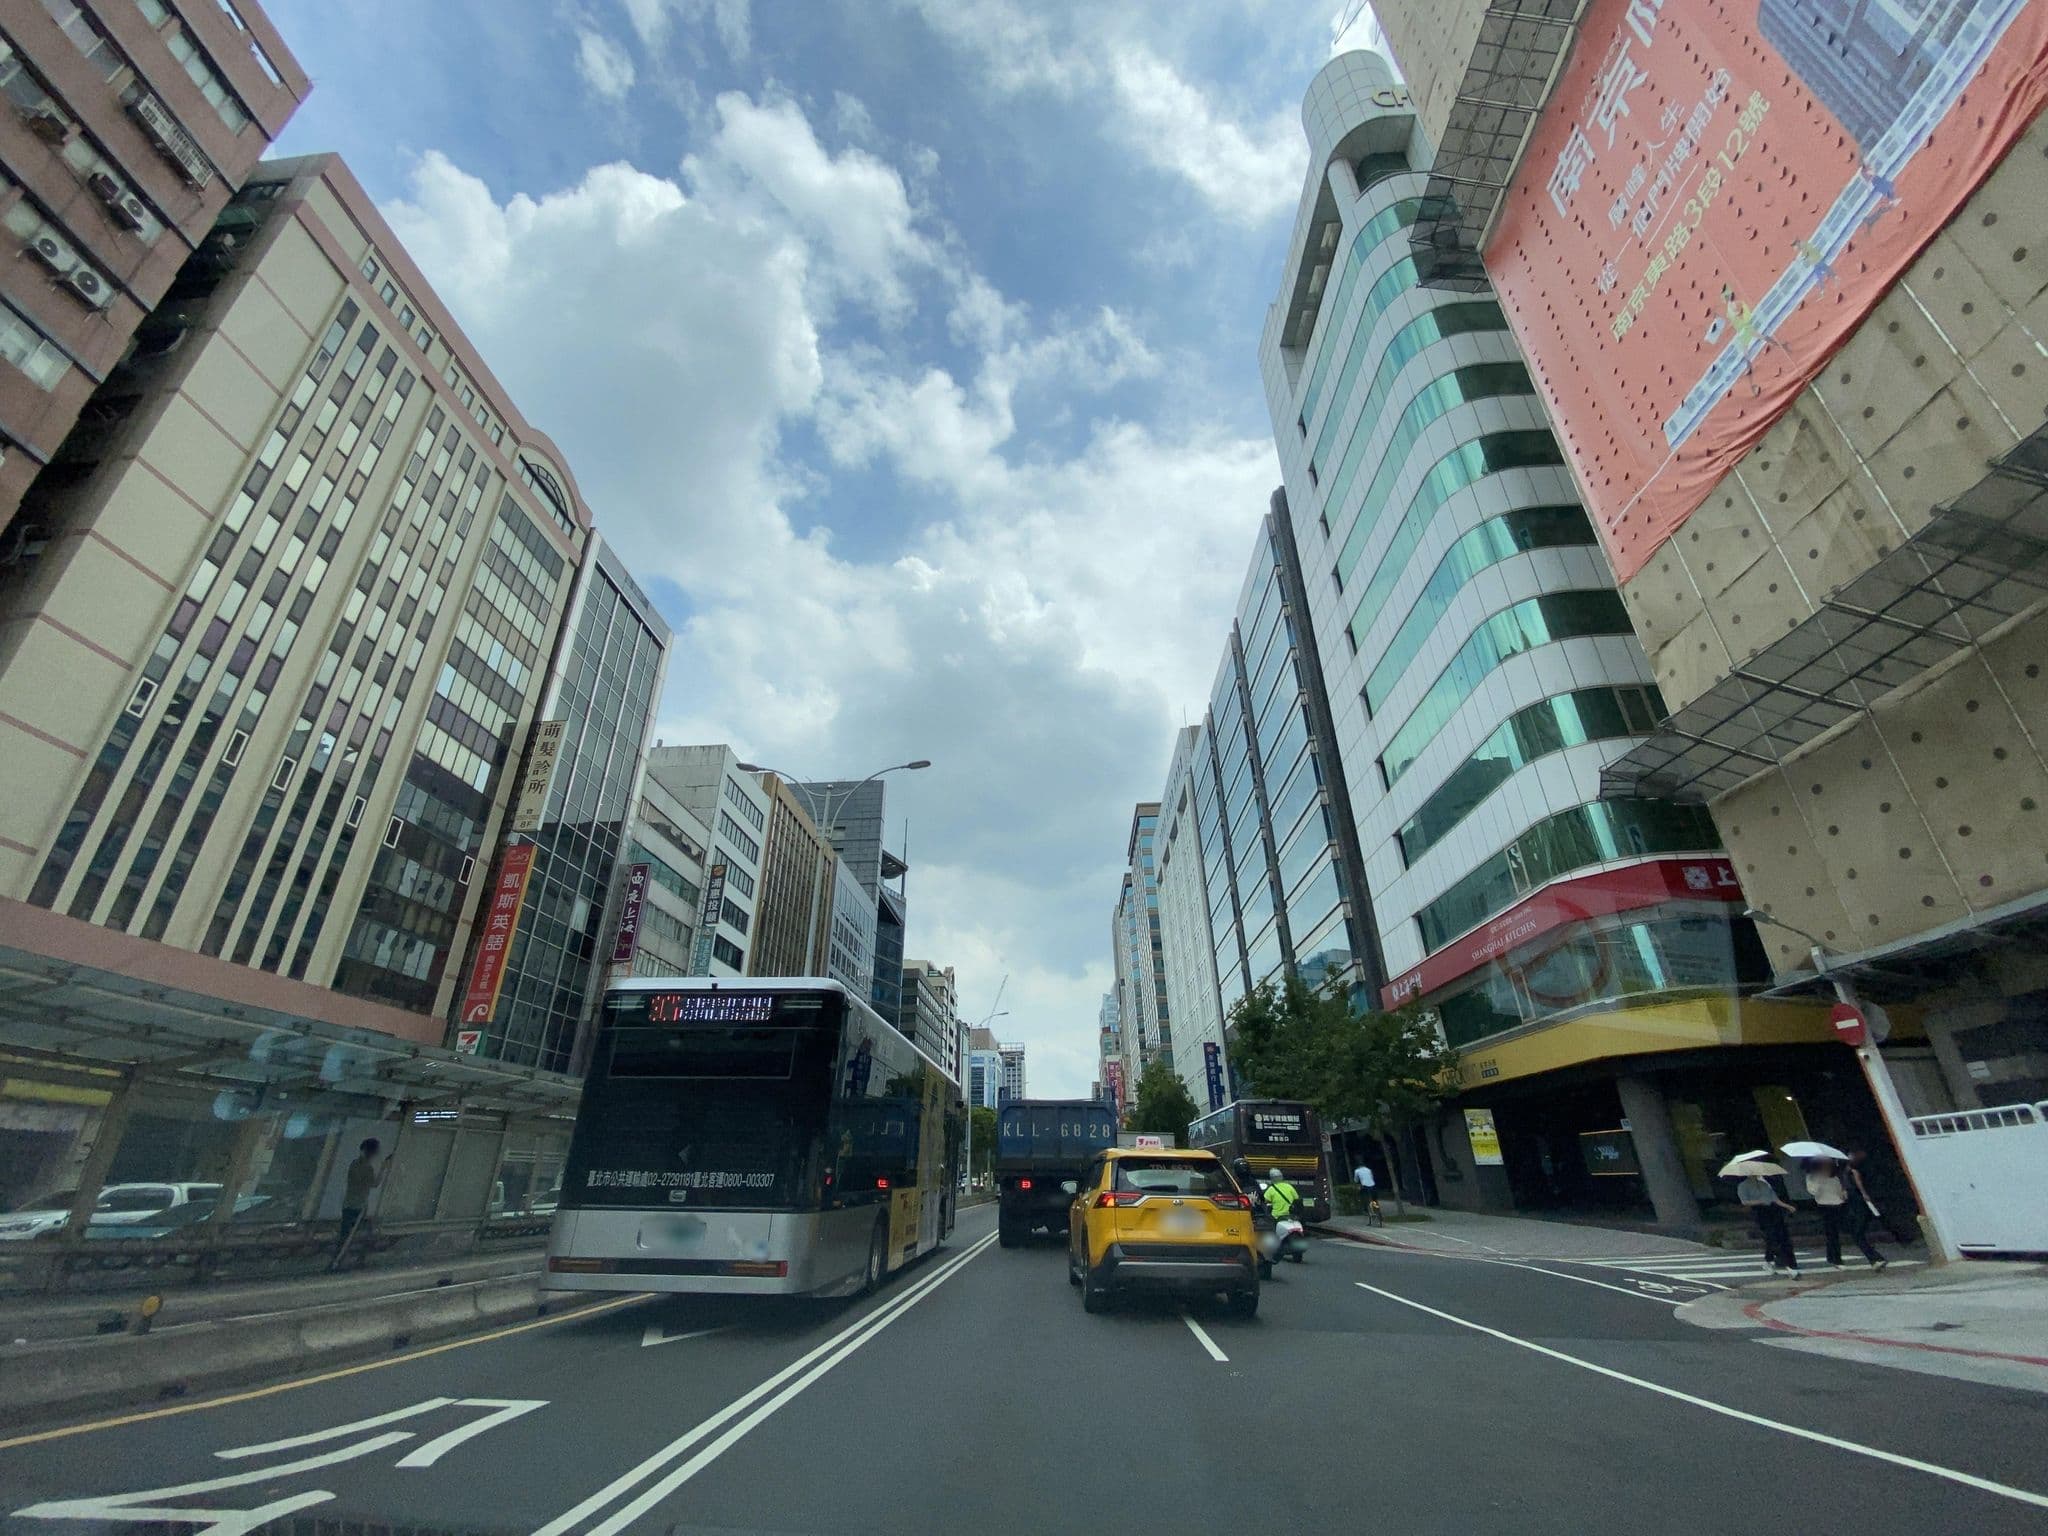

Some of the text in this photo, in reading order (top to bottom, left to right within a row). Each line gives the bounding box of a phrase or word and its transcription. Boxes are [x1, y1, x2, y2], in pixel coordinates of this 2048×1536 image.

[1610, 89, 1771, 344] 南京東路3段12號
[527, 723, 562, 796] 萌髮診所
[485, 872, 520, 951] 凱斯英語
[1471, 937, 1504, 962] SHANGHAI
[1504, 918, 1538, 946] KITCHEN
